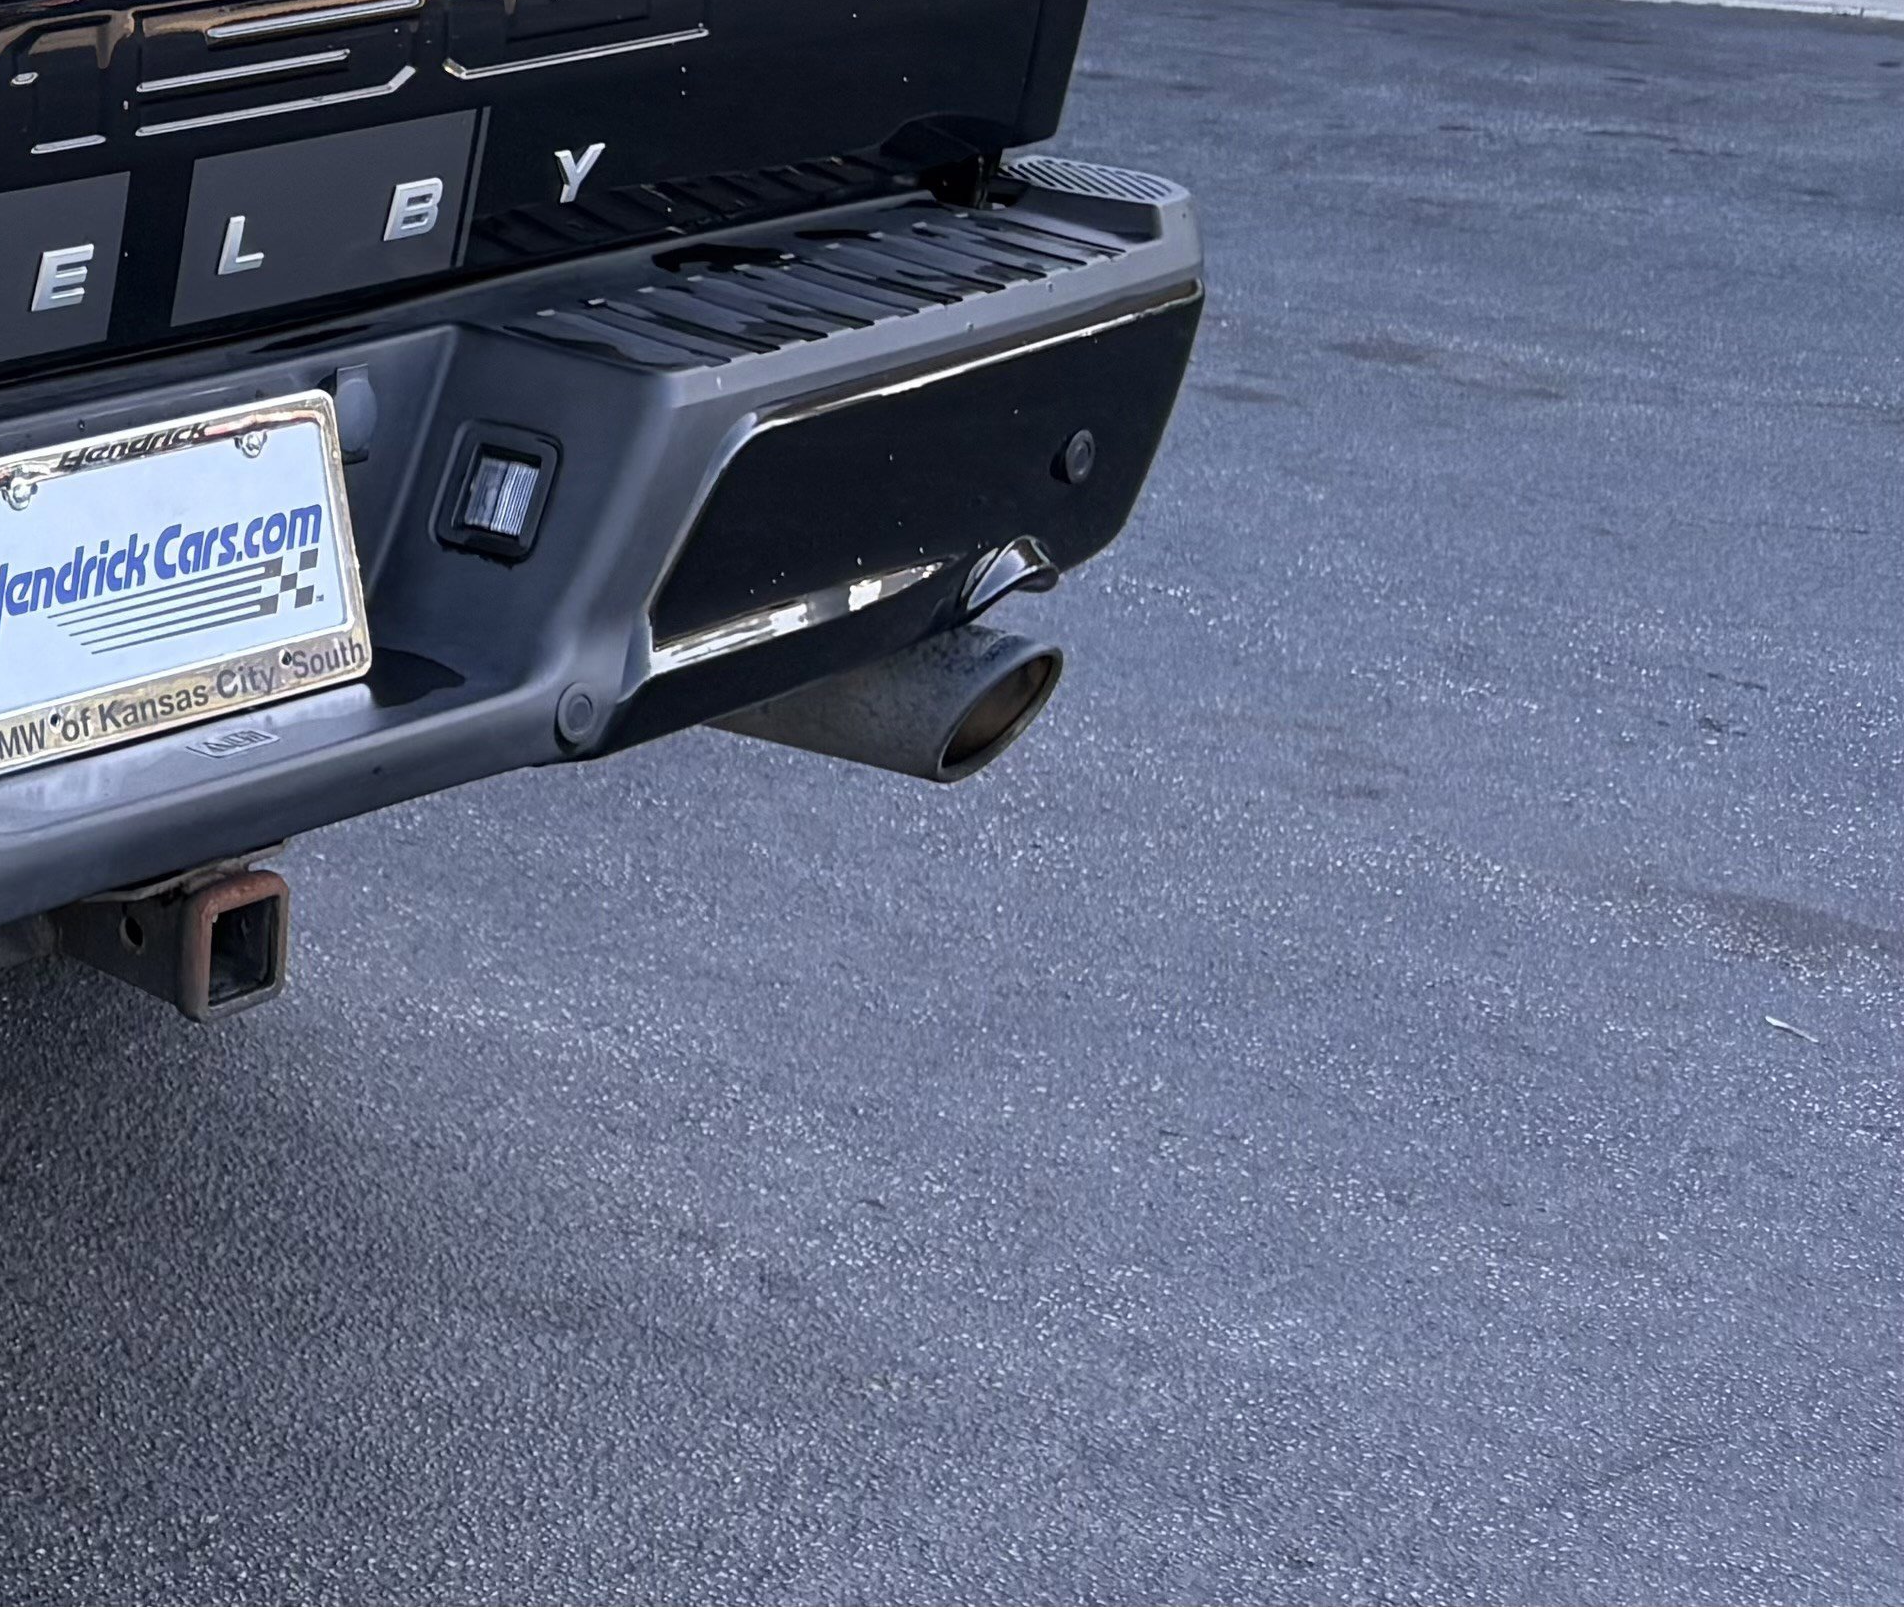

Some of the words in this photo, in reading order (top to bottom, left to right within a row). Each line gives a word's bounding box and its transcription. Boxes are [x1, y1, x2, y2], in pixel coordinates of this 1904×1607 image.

[49, 423, 211, 473] Hendrick
[60, 707, 93, 743] of
[98, 683, 209, 733] Kansas
[217, 661, 276, 700] City
[292, 638, 365, 680] South
